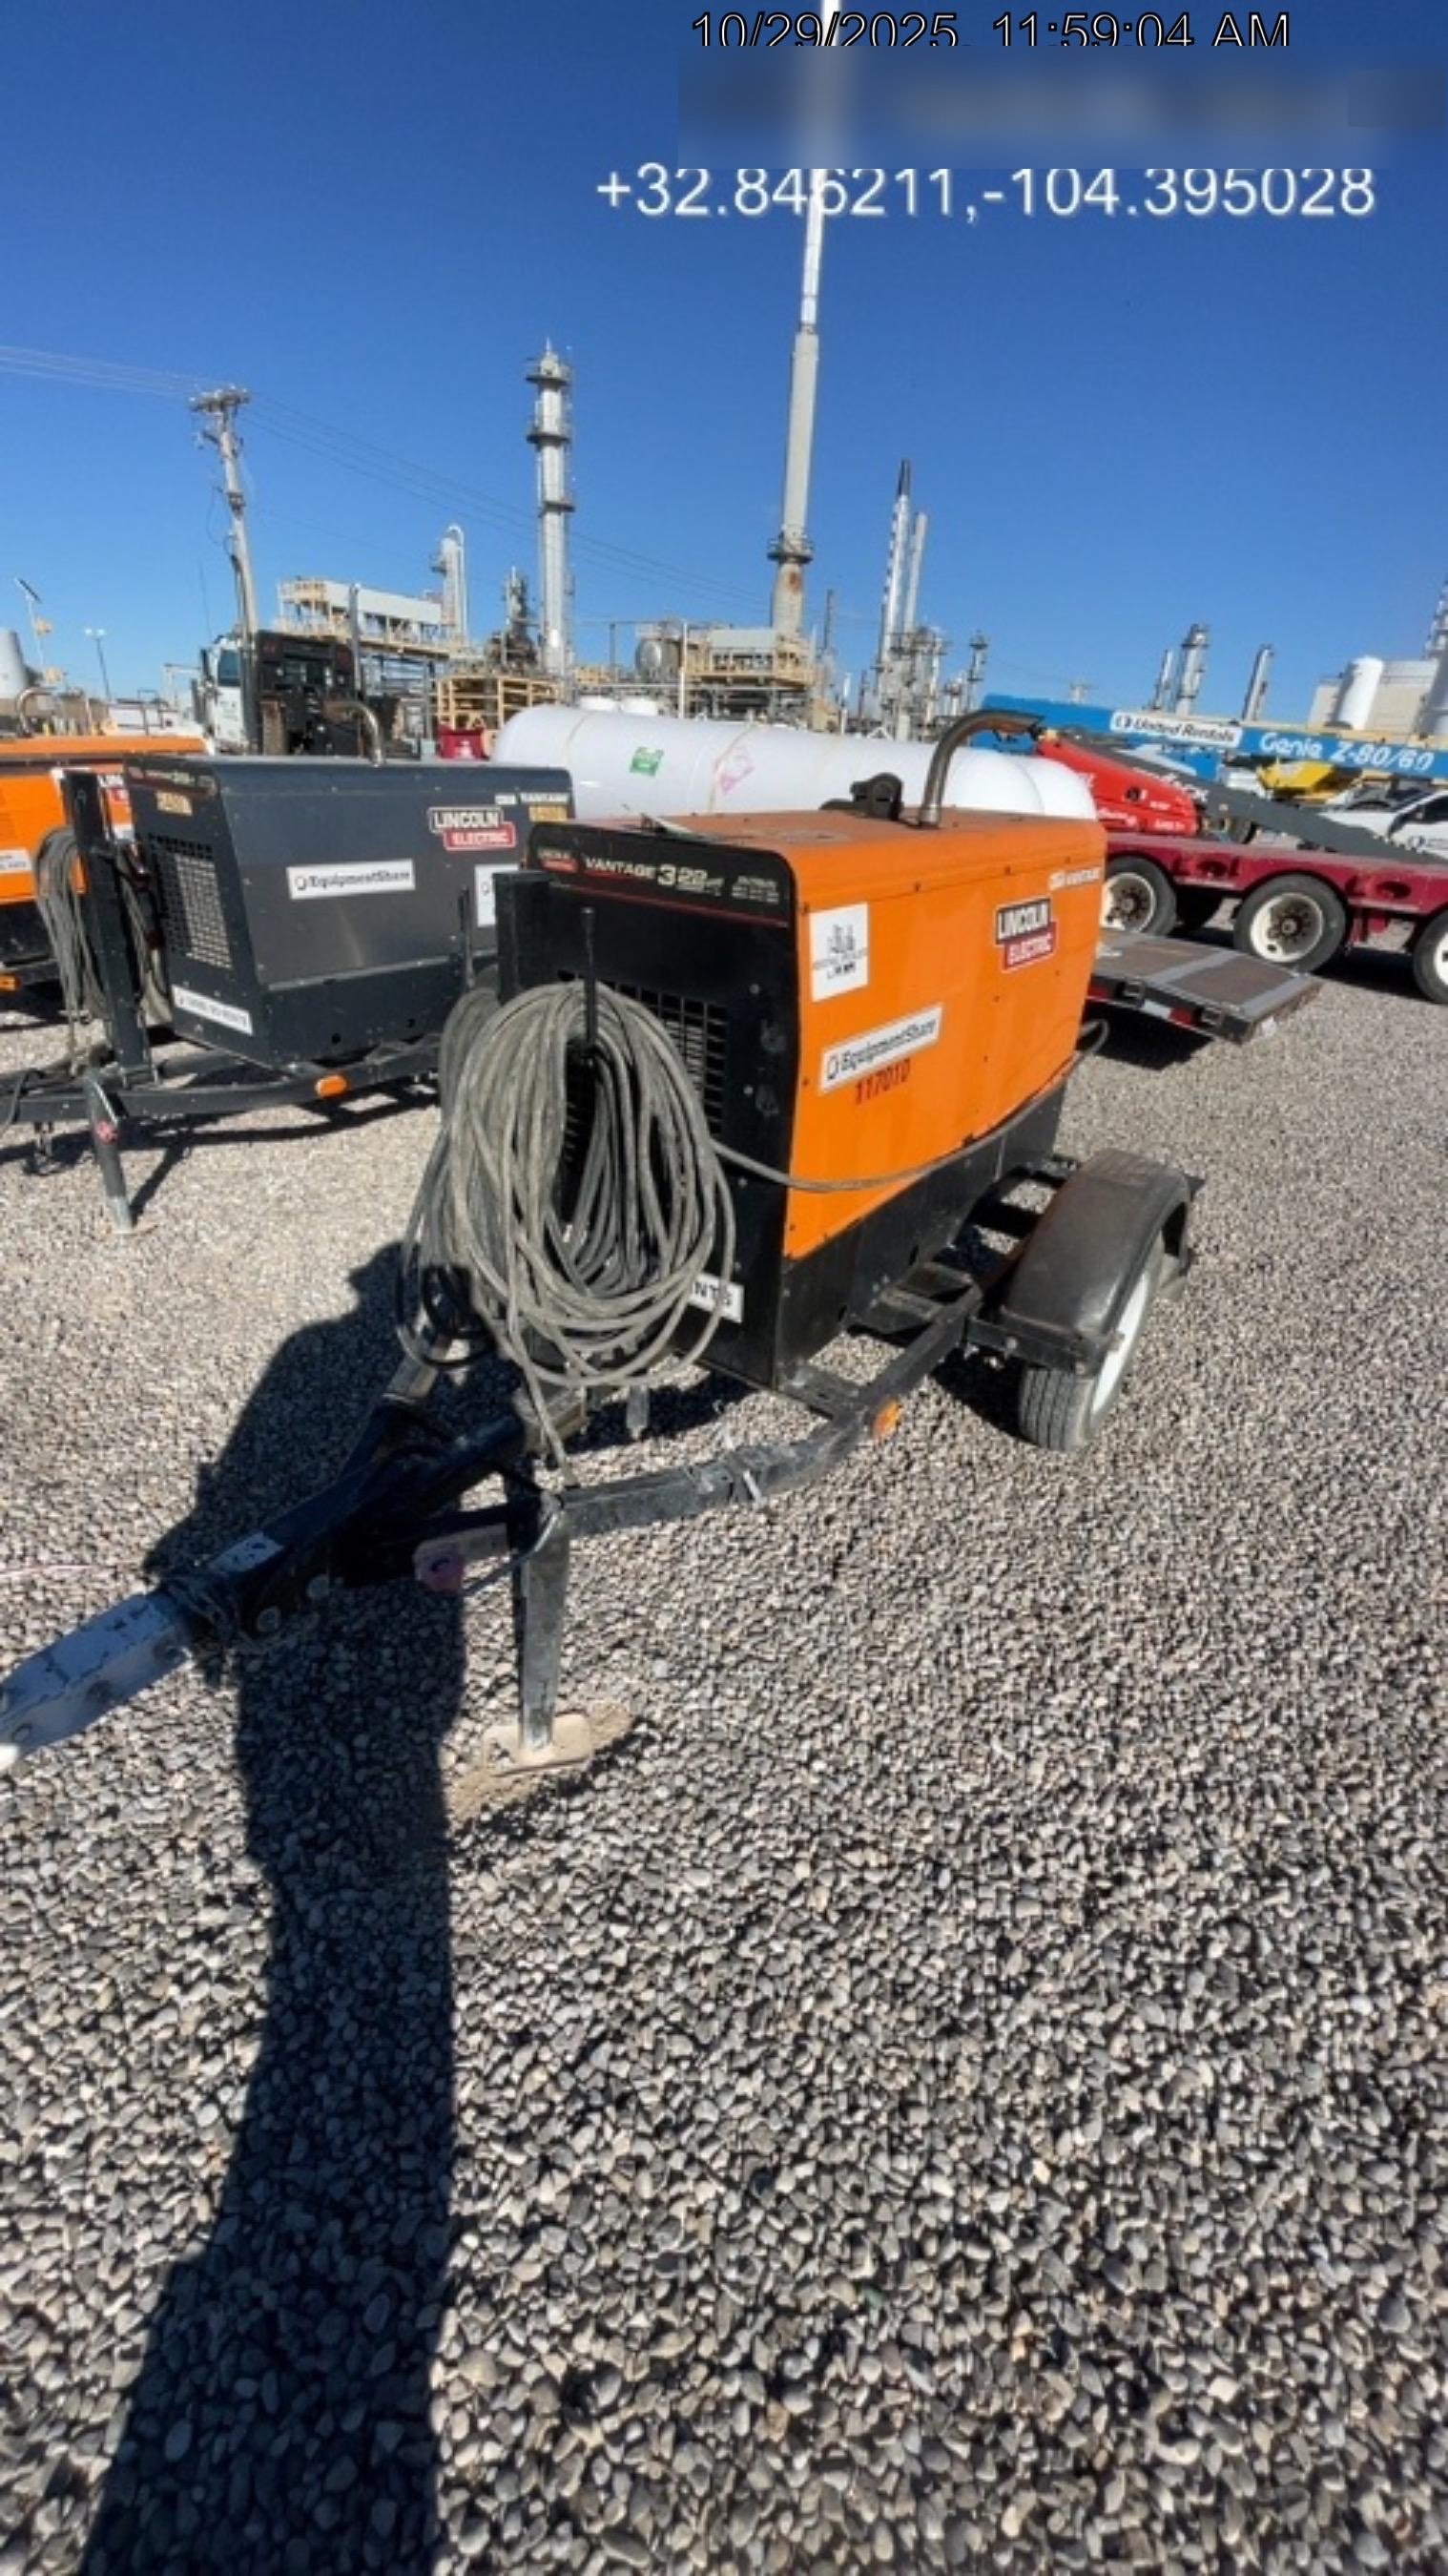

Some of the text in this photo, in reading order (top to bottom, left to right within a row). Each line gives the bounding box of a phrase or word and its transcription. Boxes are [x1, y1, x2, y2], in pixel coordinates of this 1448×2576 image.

[1135, 717, 1234, 742] United Rentals
[1259, 731, 1324, 759] Genie
[434, 811, 500, 828] LINCOLN
[308, 869, 411, 888] EquipmentShare
[585, 856, 658, 880] VANTAGE
[998, 901, 1049, 941] LINCOLN
[839, 1018, 937, 1071] EquipmentShare
